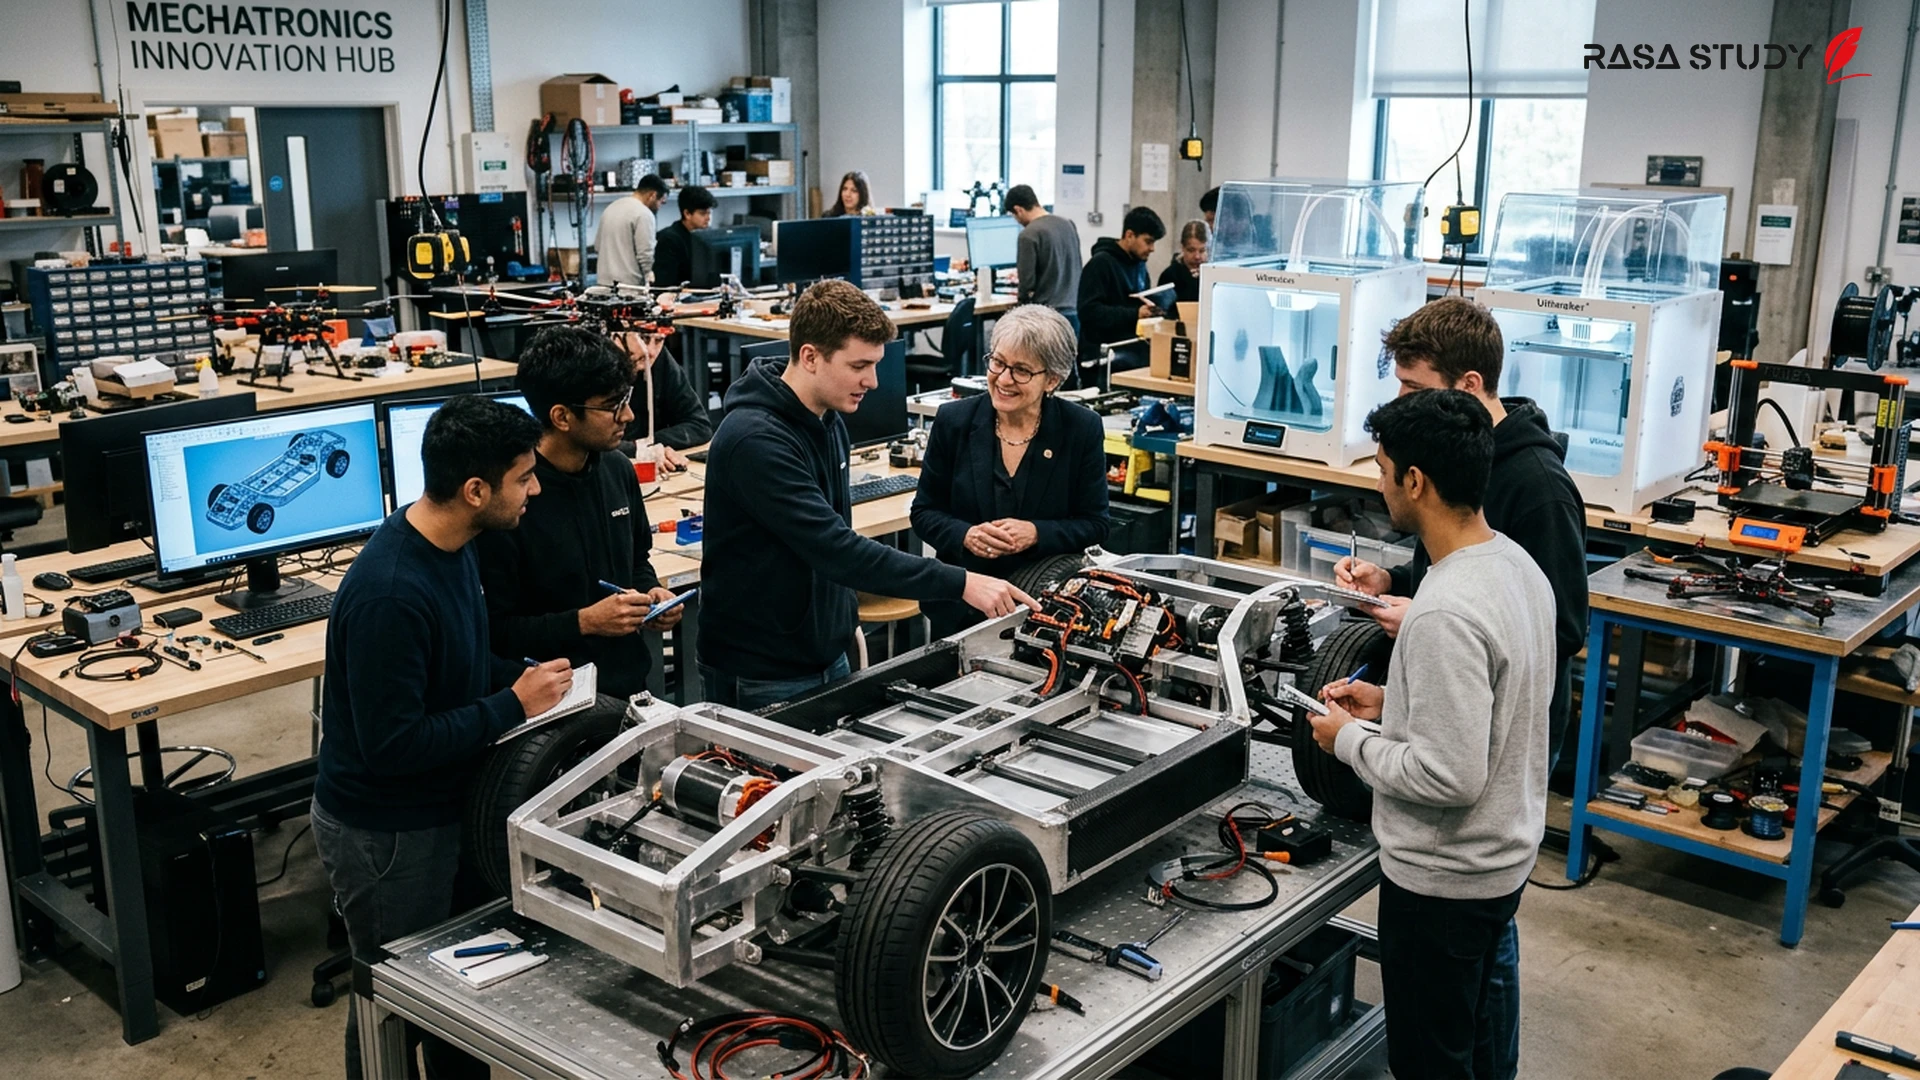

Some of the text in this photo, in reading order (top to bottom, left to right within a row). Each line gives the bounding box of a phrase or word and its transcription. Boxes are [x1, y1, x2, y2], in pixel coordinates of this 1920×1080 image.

[126, 1, 393, 39] MECHATRONICS
[131, 40, 395, 73] INNOVATION HUB
